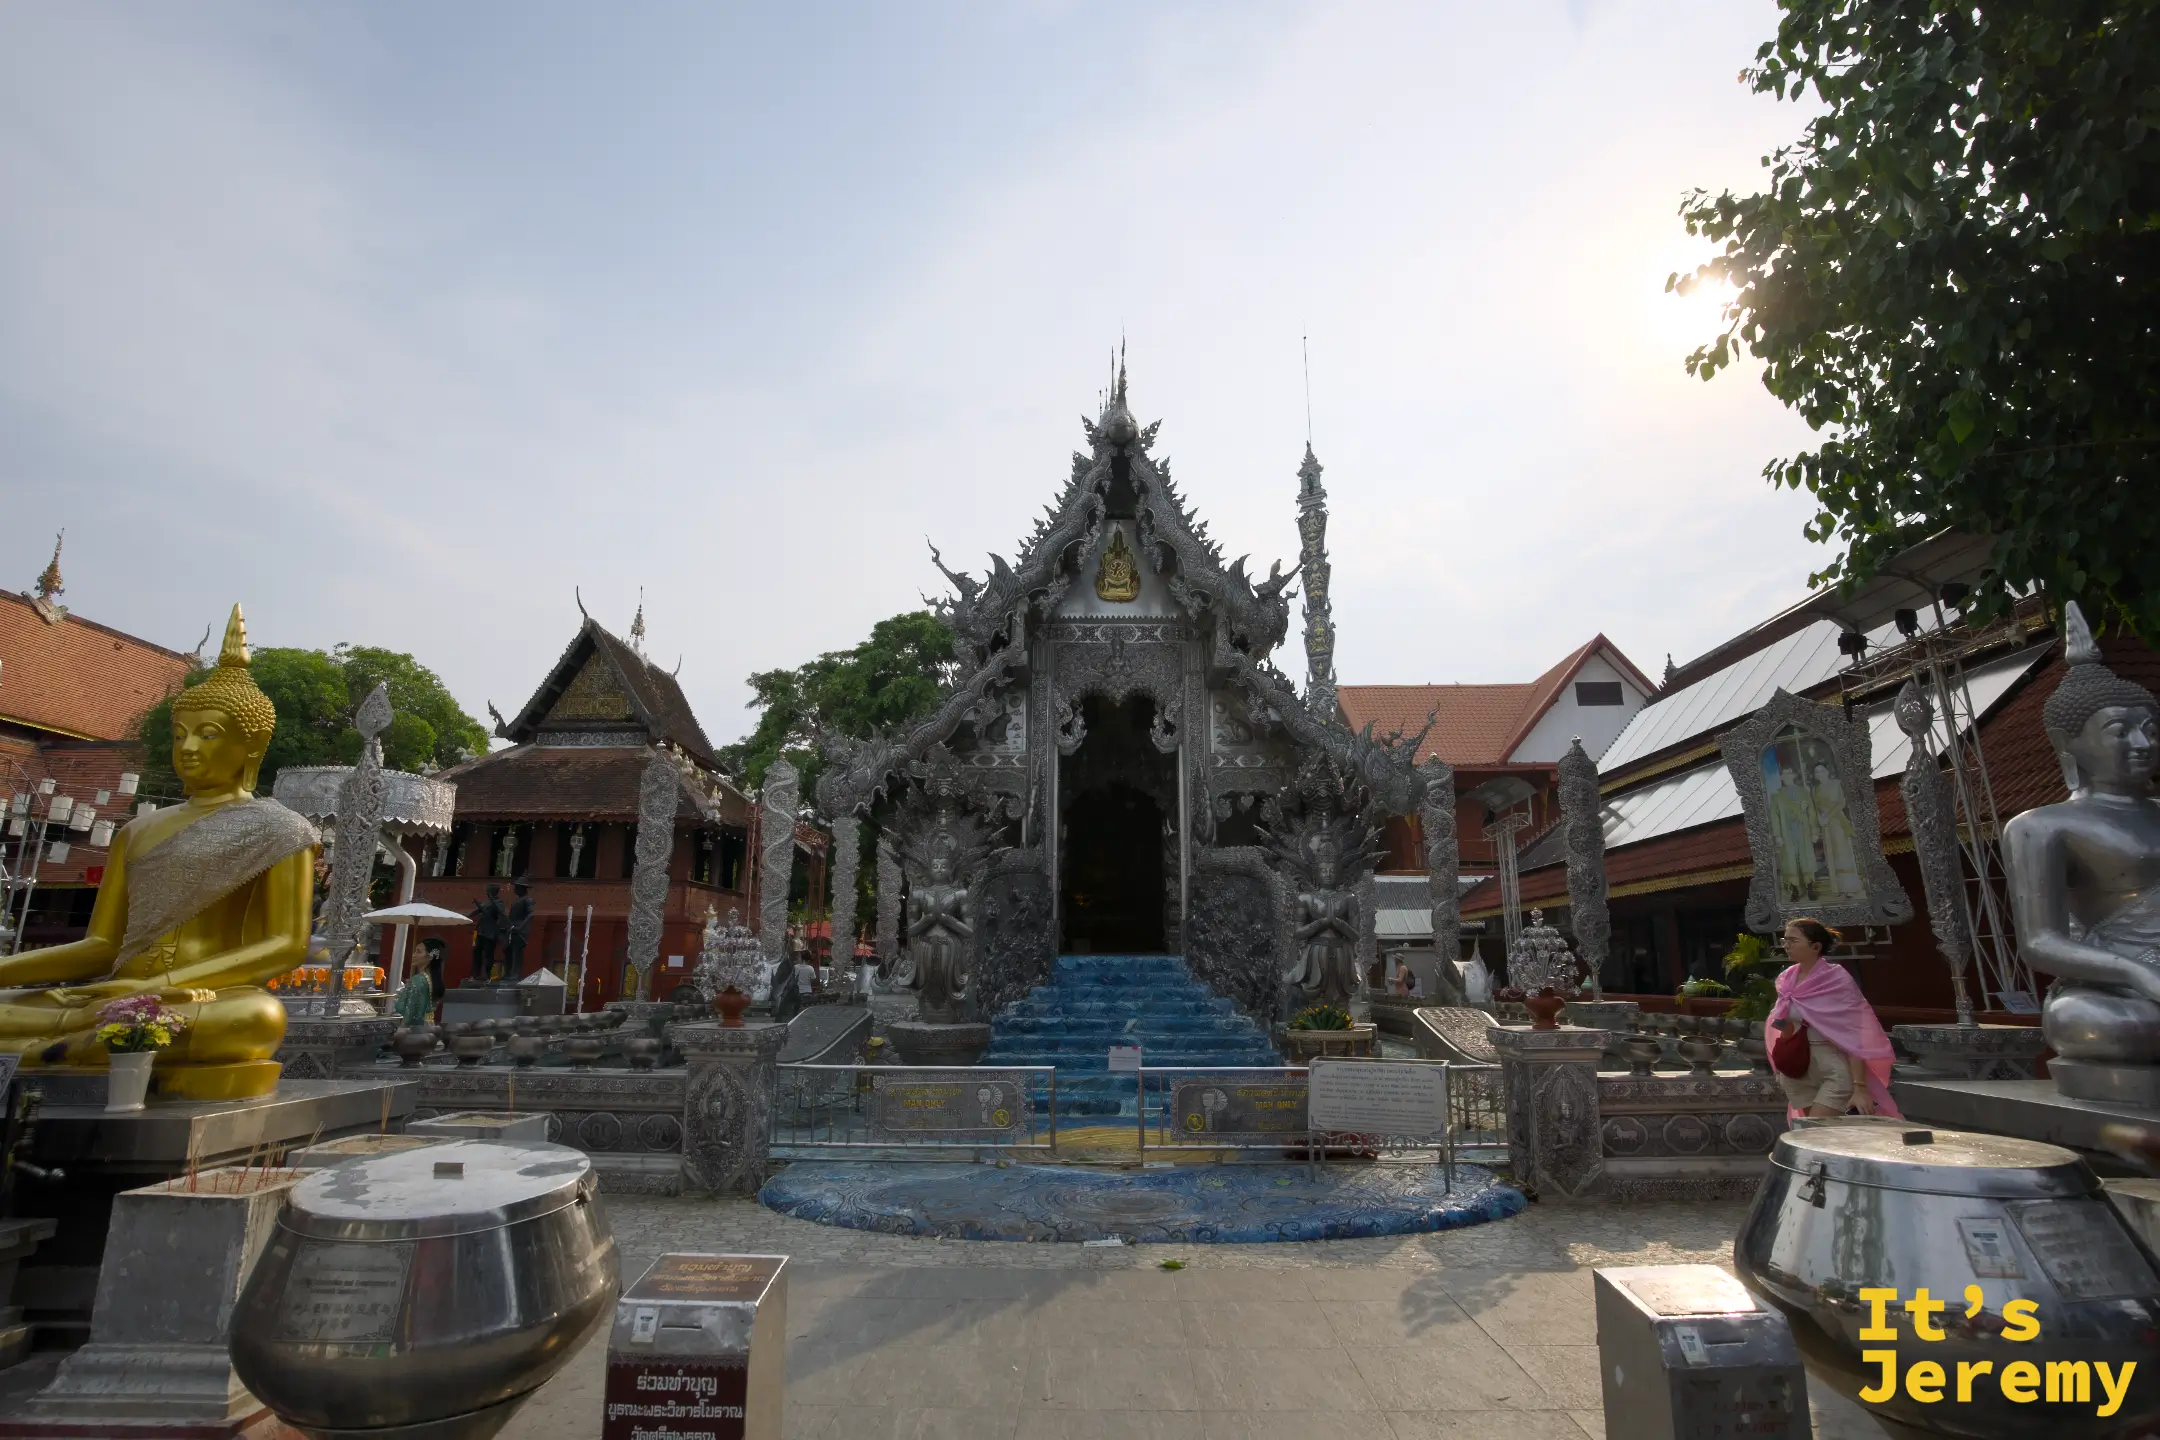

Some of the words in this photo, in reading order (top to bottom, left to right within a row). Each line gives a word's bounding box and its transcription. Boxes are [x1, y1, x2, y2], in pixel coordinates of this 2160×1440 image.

[904, 1100, 922, 1108] MAN
[926, 1100, 945, 1108] ONLY
[1277, 1101, 1297, 1109] ONLY
[637, 1369, 717, 1398] ร่วมทำบุญ
